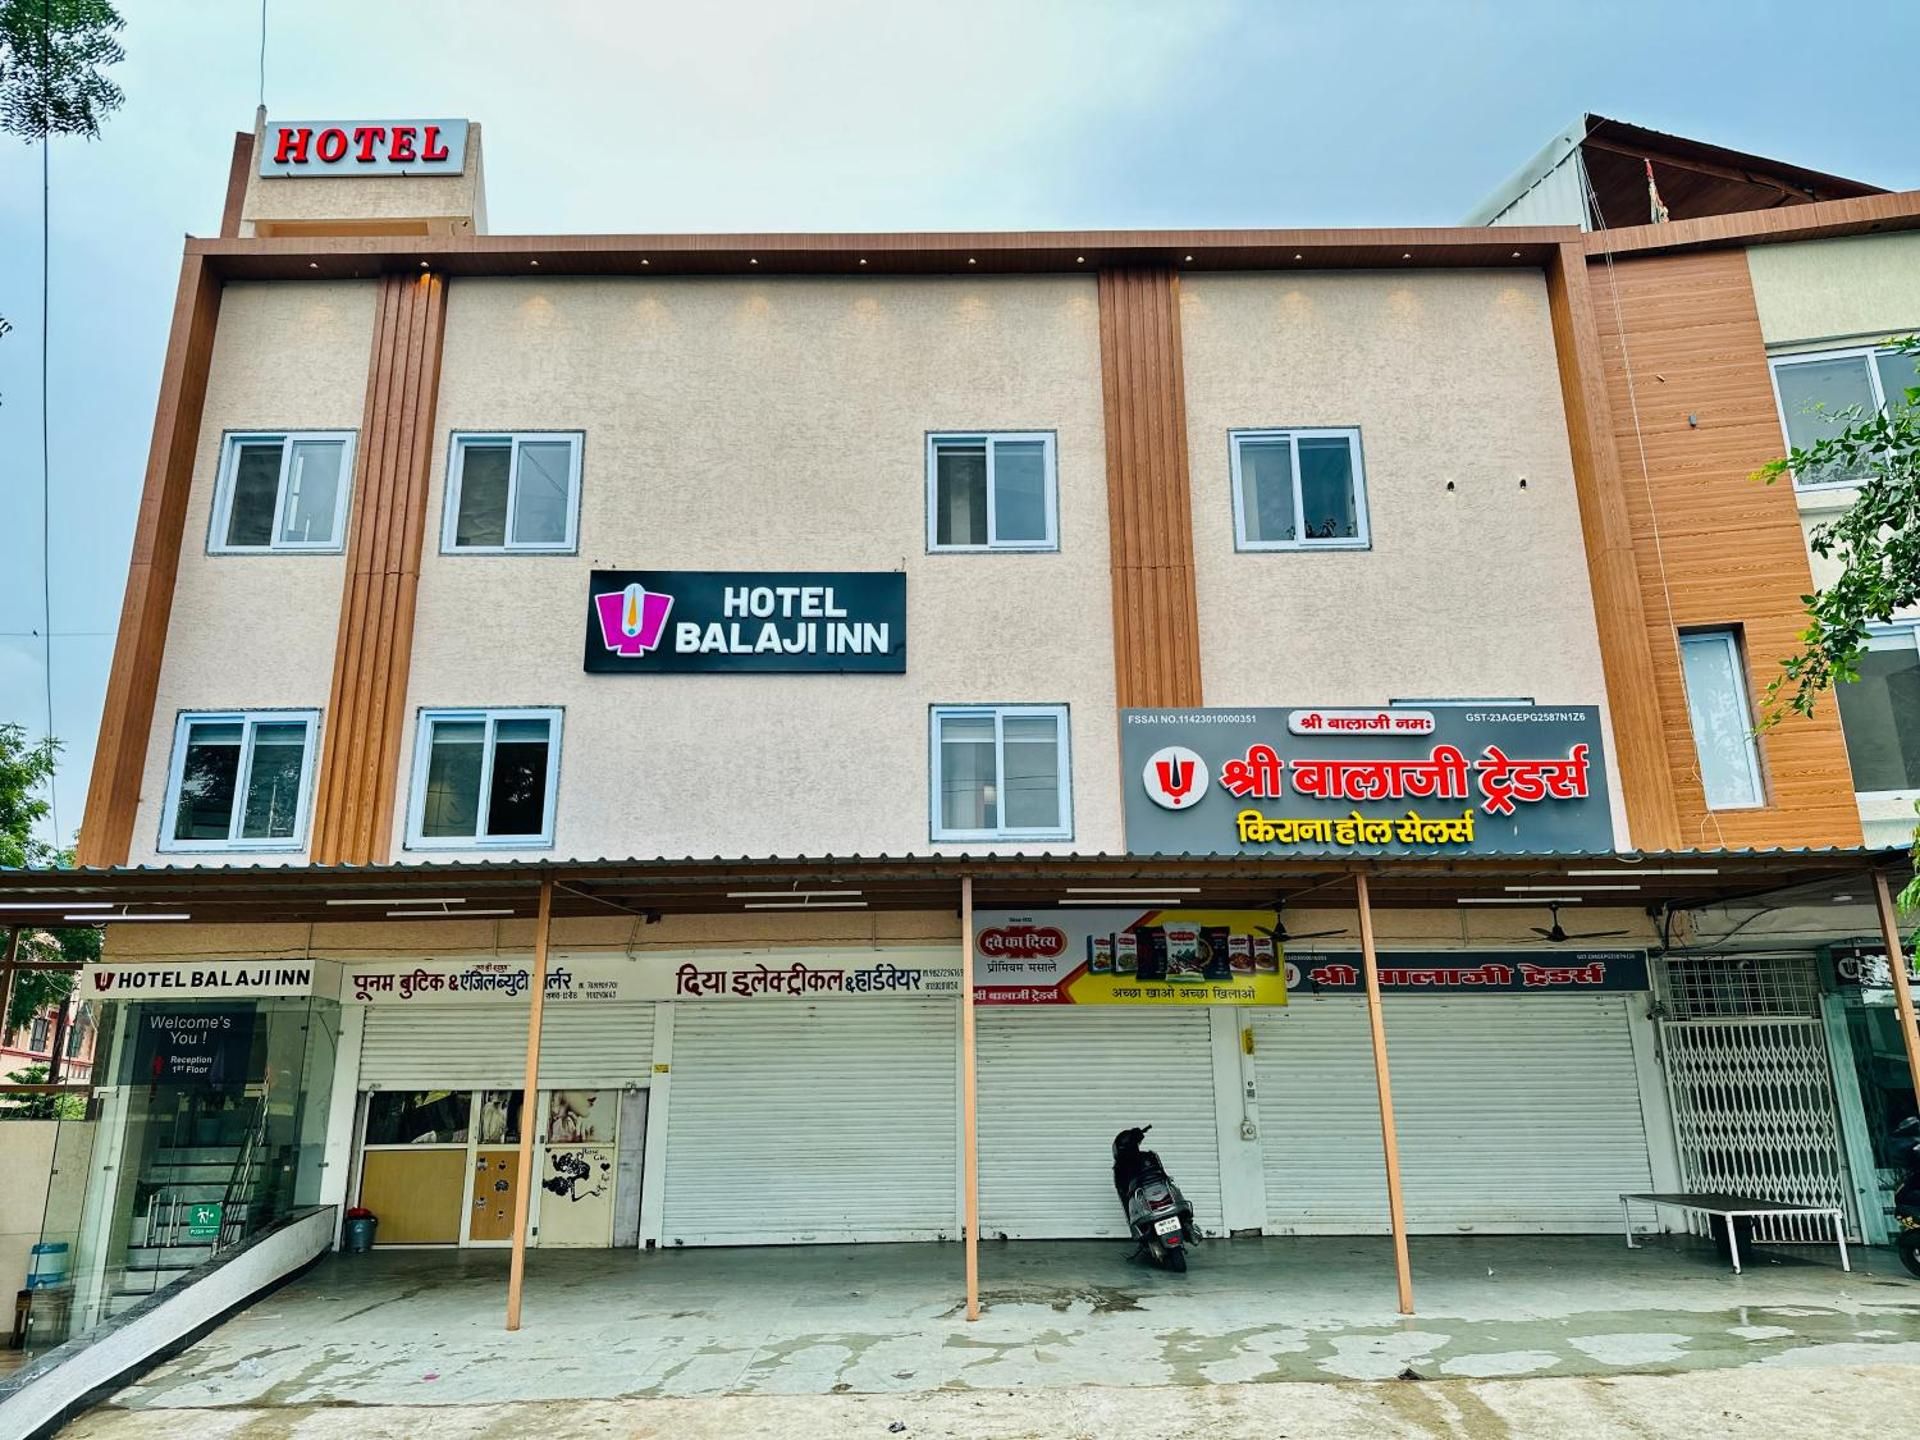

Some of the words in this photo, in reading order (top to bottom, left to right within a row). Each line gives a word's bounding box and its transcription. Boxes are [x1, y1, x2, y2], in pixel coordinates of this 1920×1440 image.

[273, 126, 449, 163] HOTEL
[723, 586, 848, 618] HOTEL
[674, 621, 817, 654] BALAJI
[826, 622, 889, 654] INN
[1128, 715, 1158, 724] FSSAI
[1300, 714, 1323, 729] श्री
[1327, 714, 1391, 730] बालाजी
[1395, 718, 1432, 729] नमः
[1220, 744, 1284, 798] श्री
[1290, 744, 1470, 800] बालाजी
[1475, 744, 1590, 815] ट्रेडर्स
[1236, 810, 1332, 843] किराना
[1333, 810, 1394, 845] होल
[1395, 809, 1474, 844] सेलर्स
[118, 972, 186, 988] HOTEL
[191, 969, 271, 987] BALAJI
[275, 969, 310, 985] INN
[352, 974, 395, 1001] पूनम
[399, 968, 445, 999] बुटिक
[448, 974, 459, 991] &
[676, 963, 727, 996] दिया
[150, 1016, 231, 1029] Welcome's
[170, 1032, 197, 1044] You
[170, 1055, 212, 1065] Reception
[186, 1065, 208, 1074] Floor
